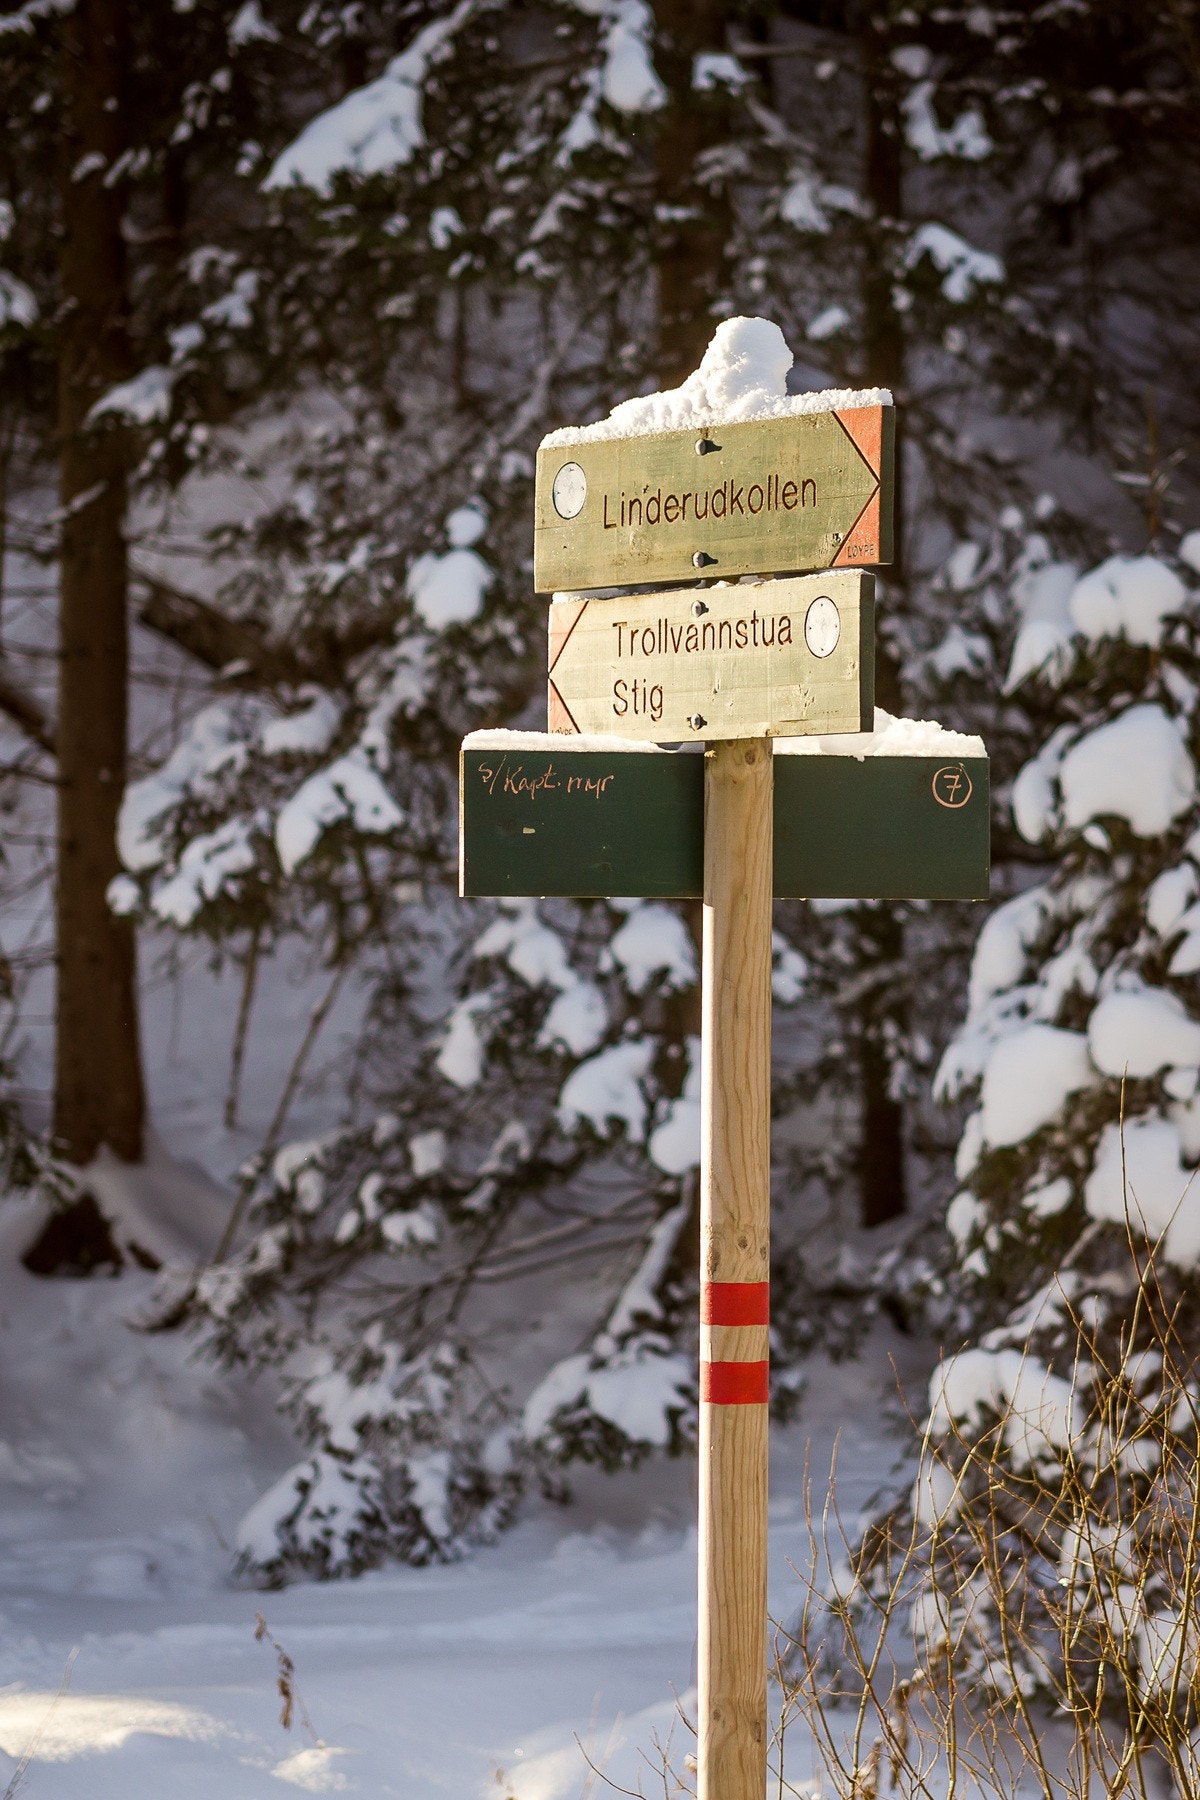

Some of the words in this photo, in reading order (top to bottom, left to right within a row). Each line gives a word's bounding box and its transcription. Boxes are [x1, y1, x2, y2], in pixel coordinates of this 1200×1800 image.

[603, 474, 817, 529] Linderudkollen
[612, 610, 793, 657] Trollvannstua
[612, 678, 664, 721] Stig
